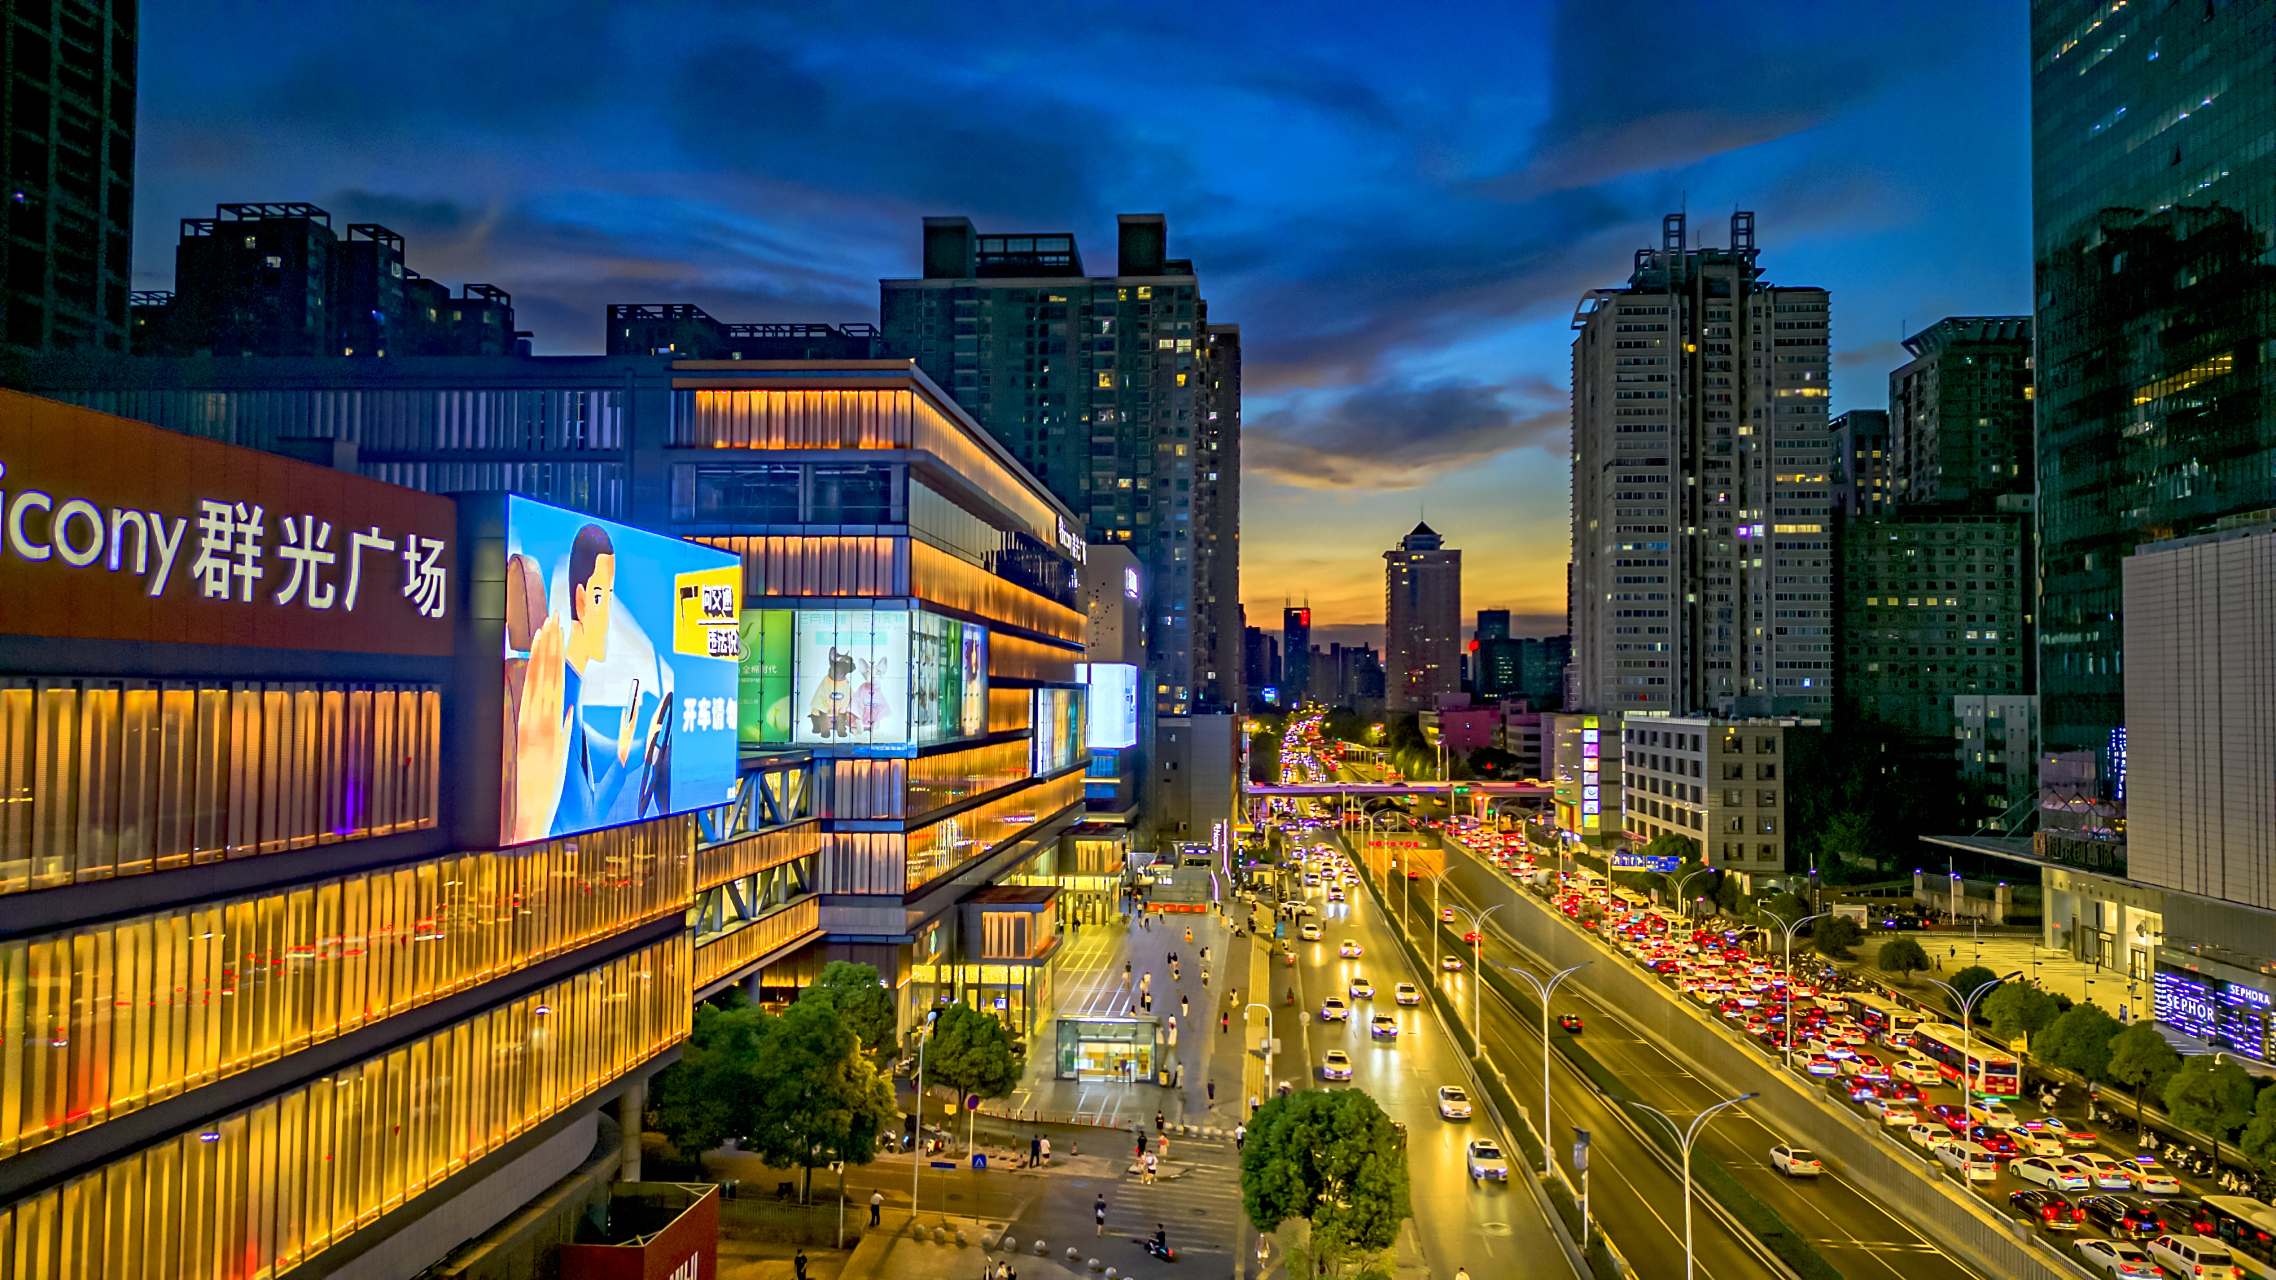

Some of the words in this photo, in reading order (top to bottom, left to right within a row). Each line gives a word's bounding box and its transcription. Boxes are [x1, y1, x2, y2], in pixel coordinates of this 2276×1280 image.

[193, 498, 447, 618] 群光广场
[702, 584, 734, 613] 向交通
[743, 665, 778, 674] 全棉时代
[2166, 993, 2215, 1022] SEPHOR
[2230, 984, 2270, 1005] SEPHORA
